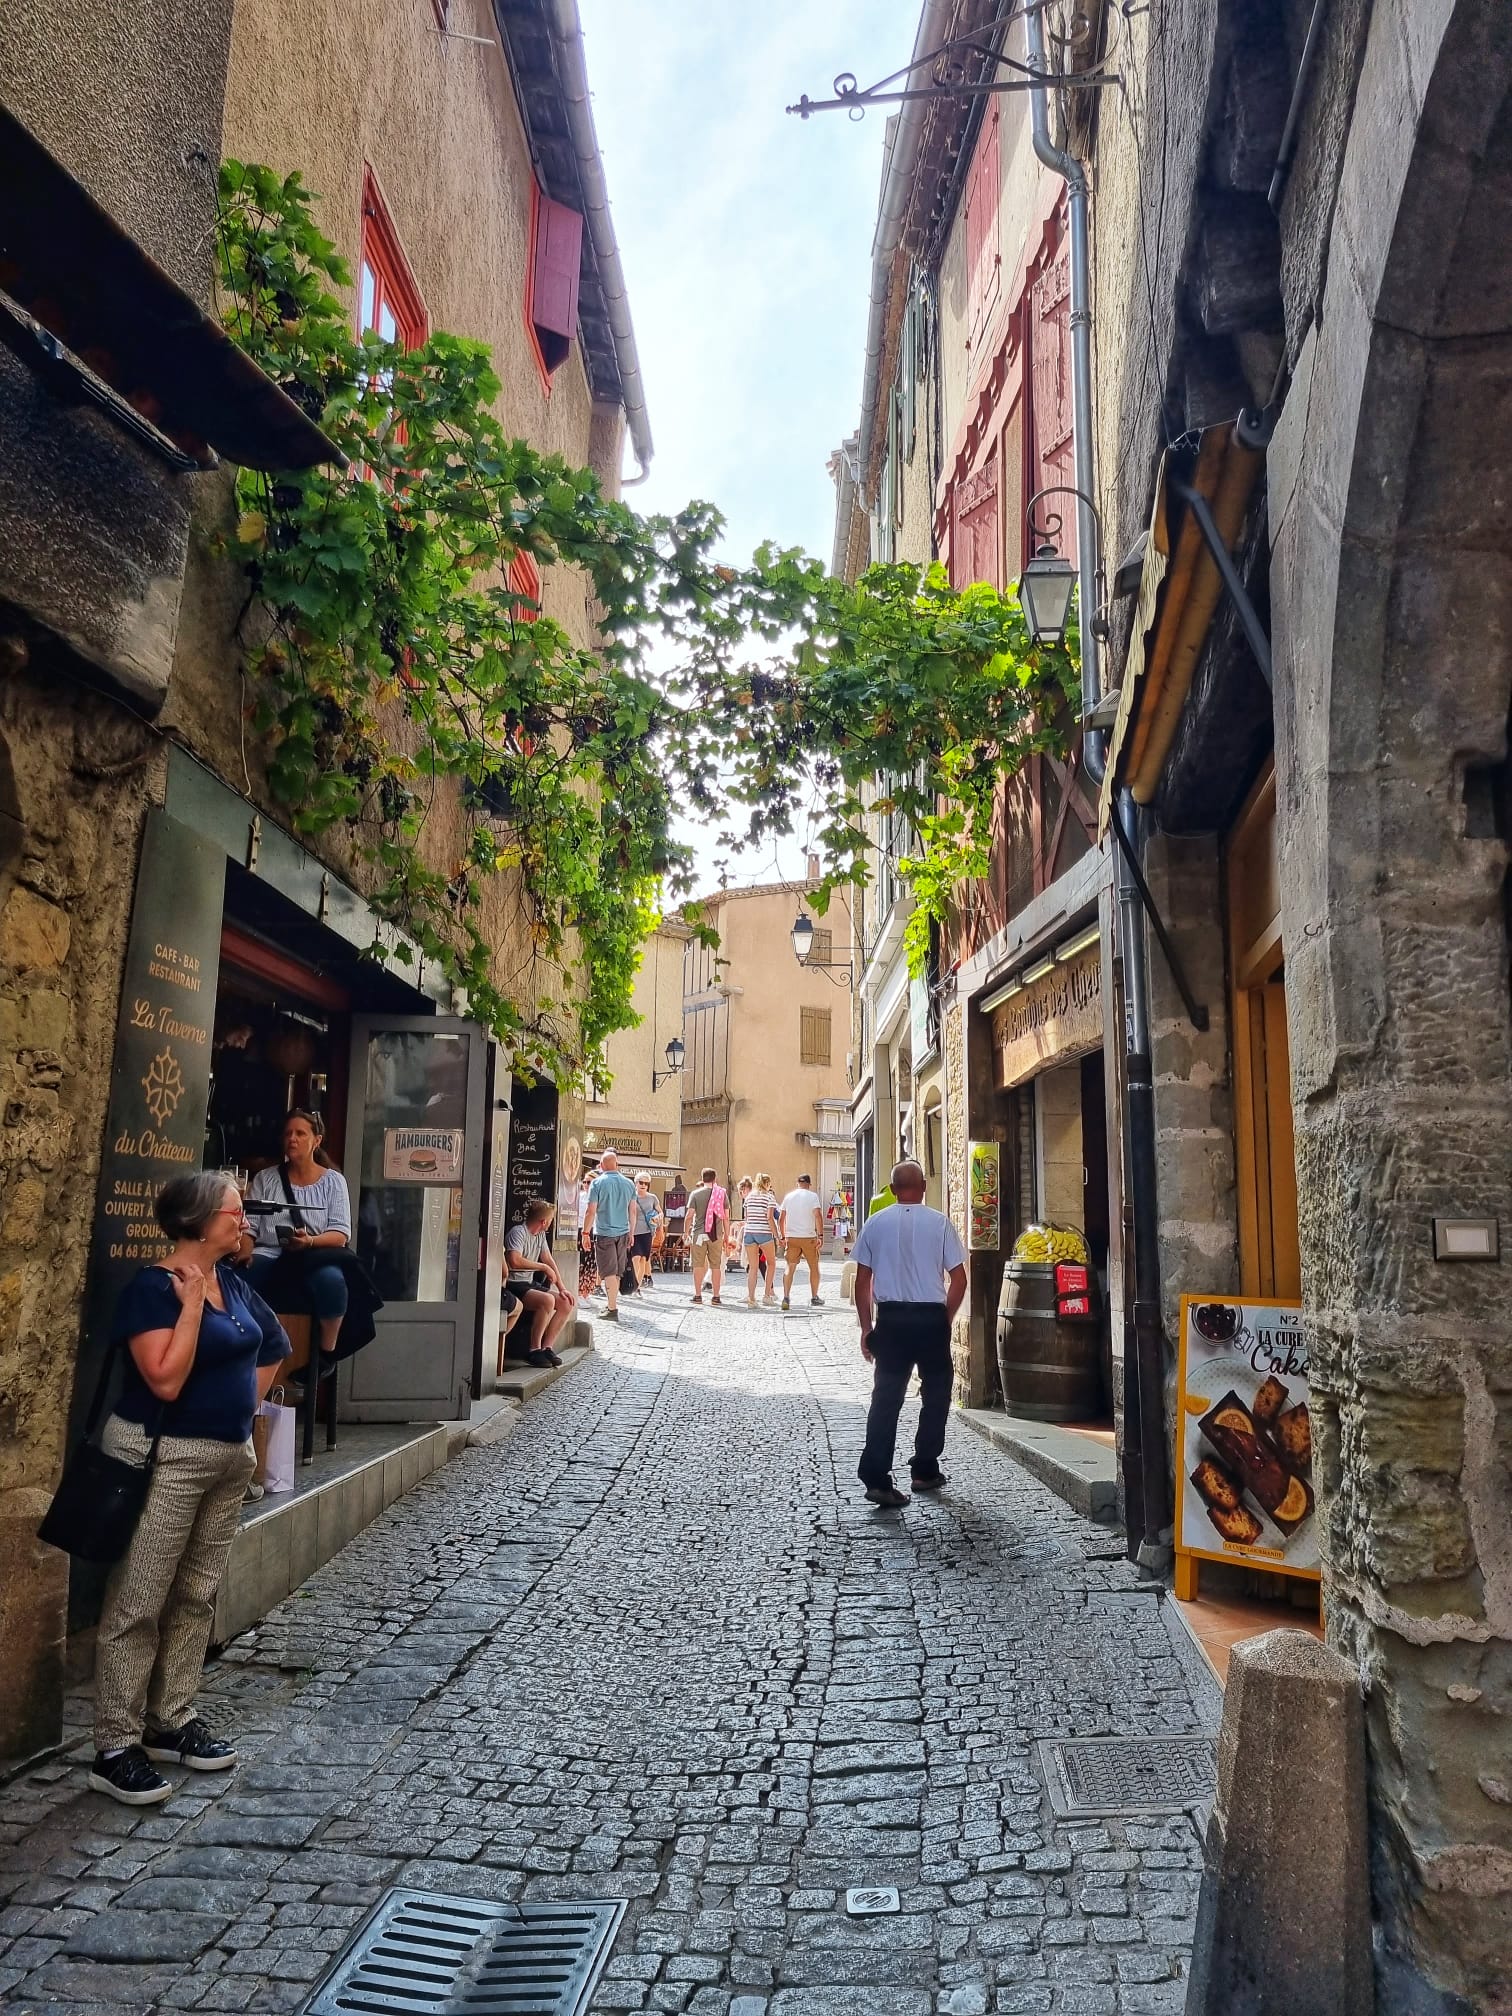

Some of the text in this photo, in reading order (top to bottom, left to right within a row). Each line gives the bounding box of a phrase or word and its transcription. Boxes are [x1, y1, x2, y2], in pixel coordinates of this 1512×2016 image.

[155, 943, 178, 964] CAFE
[183, 954, 201, 972] BAR
[149, 961, 203, 993] RESTAURANT
[130, 998, 207, 1045] La Taverne
[115, 1129, 197, 1163] du Château
[394, 1133, 453, 1153] HAMBURGERS
[598, 1133, 643, 1148] Amorino
[649, 1168, 674, 1177] NATURALE
[114, 1180, 143, 1197] SALLE
[144, 1180, 153, 1198] À
[105, 1200, 155, 1218] OUVERT À
[110, 1243, 123, 1259] 04
[125, 1243, 138, 1259] 68
[141, 1244, 153, 1259] 25
[155, 1245, 168, 1259] 95
[1280, 1314, 1299, 1326] N°2
[1258, 1330, 1304, 1347] LA CURE
